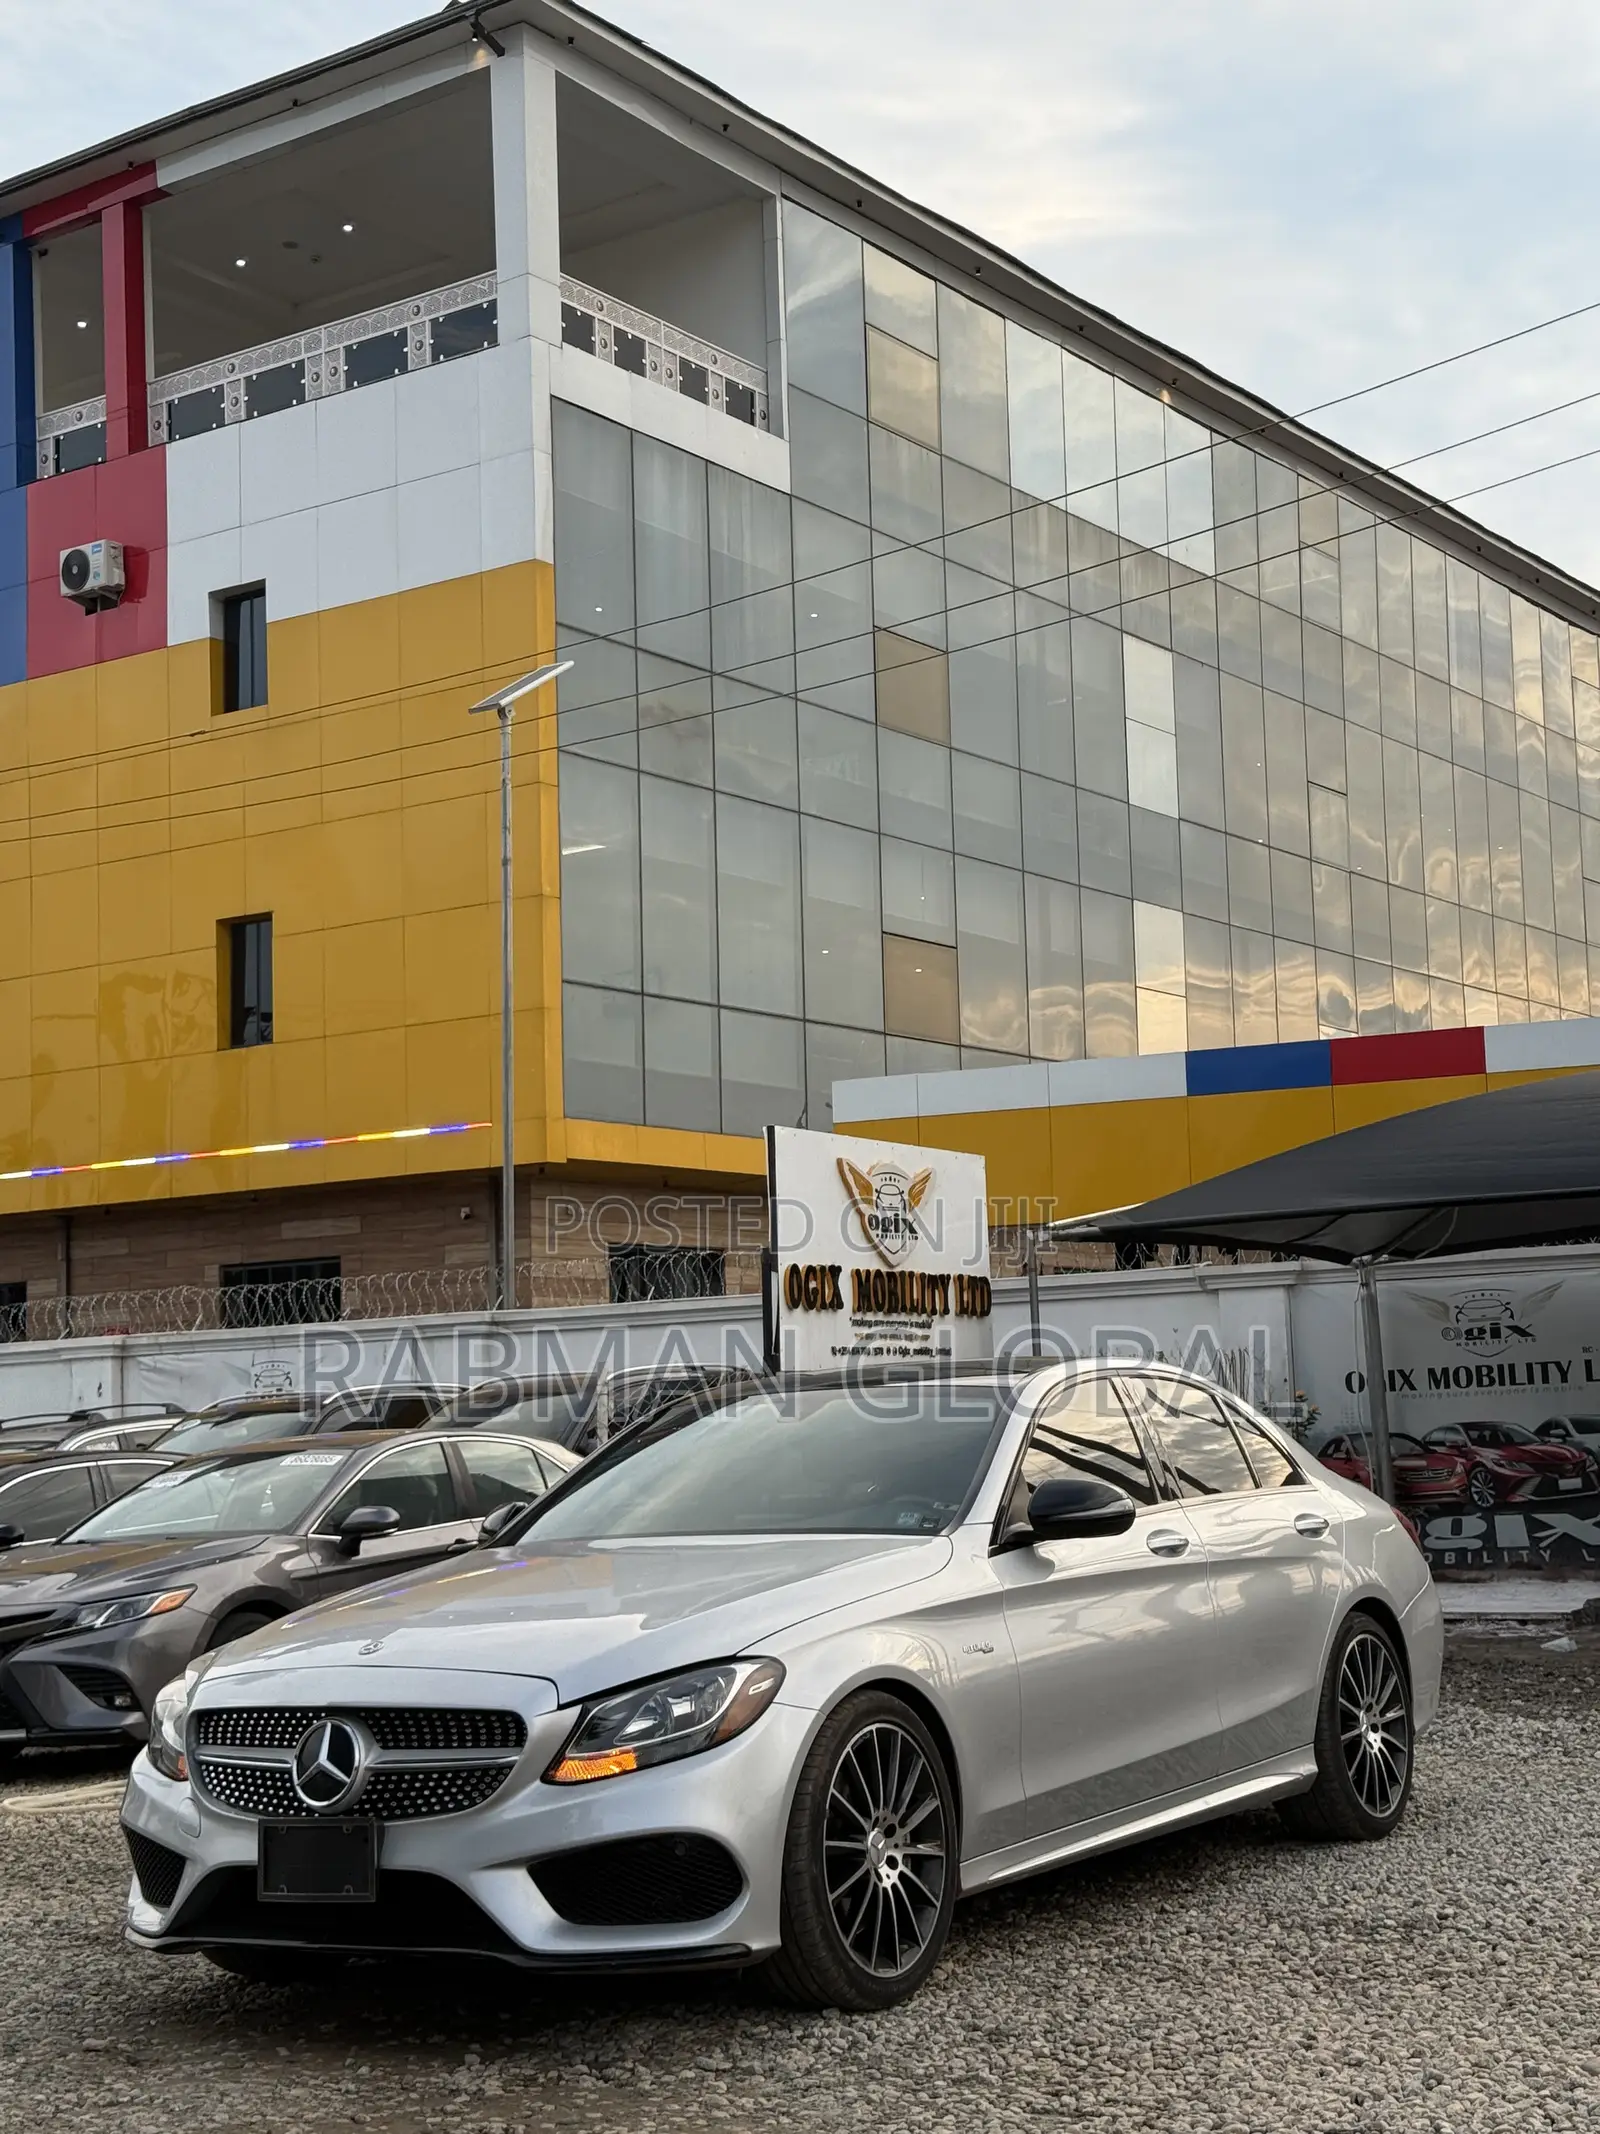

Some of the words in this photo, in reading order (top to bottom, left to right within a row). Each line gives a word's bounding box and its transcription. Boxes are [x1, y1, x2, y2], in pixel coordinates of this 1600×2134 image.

[784, 1262, 844, 1312] OGIX
[851, 1268, 951, 1316] MOBILITY
[953, 1273, 992, 1318] LTD
[1345, 1367, 1418, 1394] OIX
[1428, 1360, 1572, 1390] MOBILITY
[1423, 1551, 1550, 1564] OBILITY
